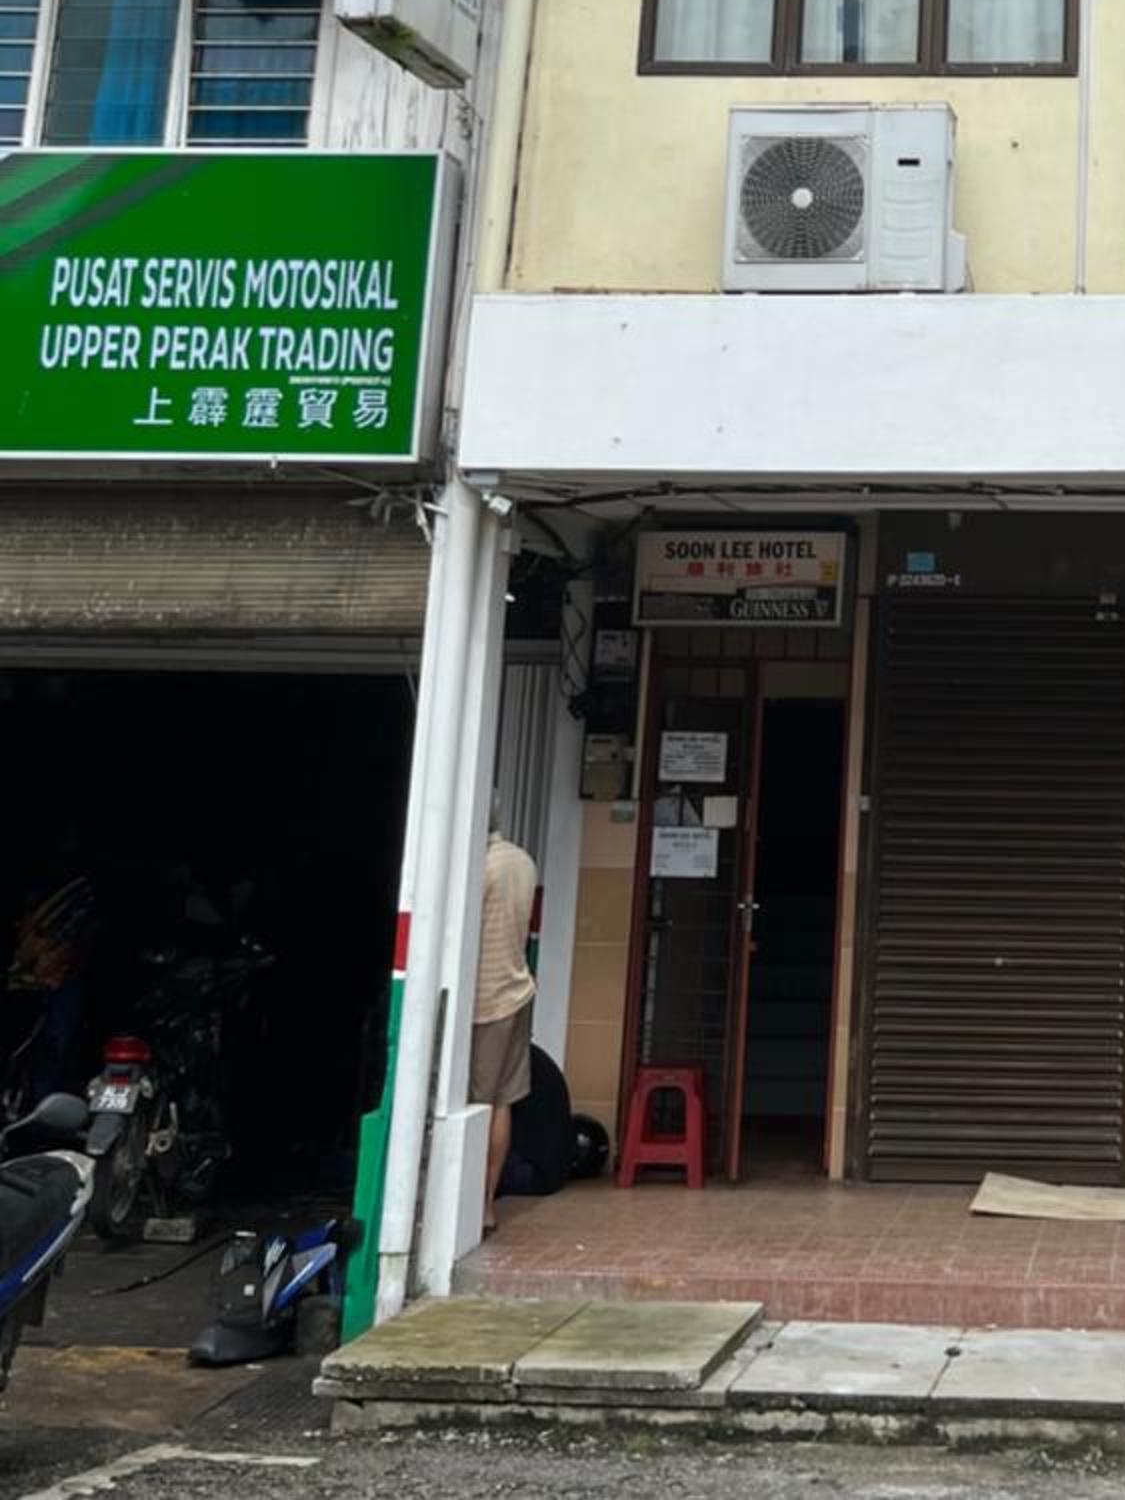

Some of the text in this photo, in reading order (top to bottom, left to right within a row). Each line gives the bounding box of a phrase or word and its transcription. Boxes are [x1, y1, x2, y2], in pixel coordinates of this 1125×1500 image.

[51, 258, 397, 309] PUSAT SERVIS MOTOSIKAL
[41, 325, 394, 372] UPPER PERAK TRADING
[664, 541, 817, 560] SOON LEE HOTEL
[729, 598, 809, 618] GUINNESS
